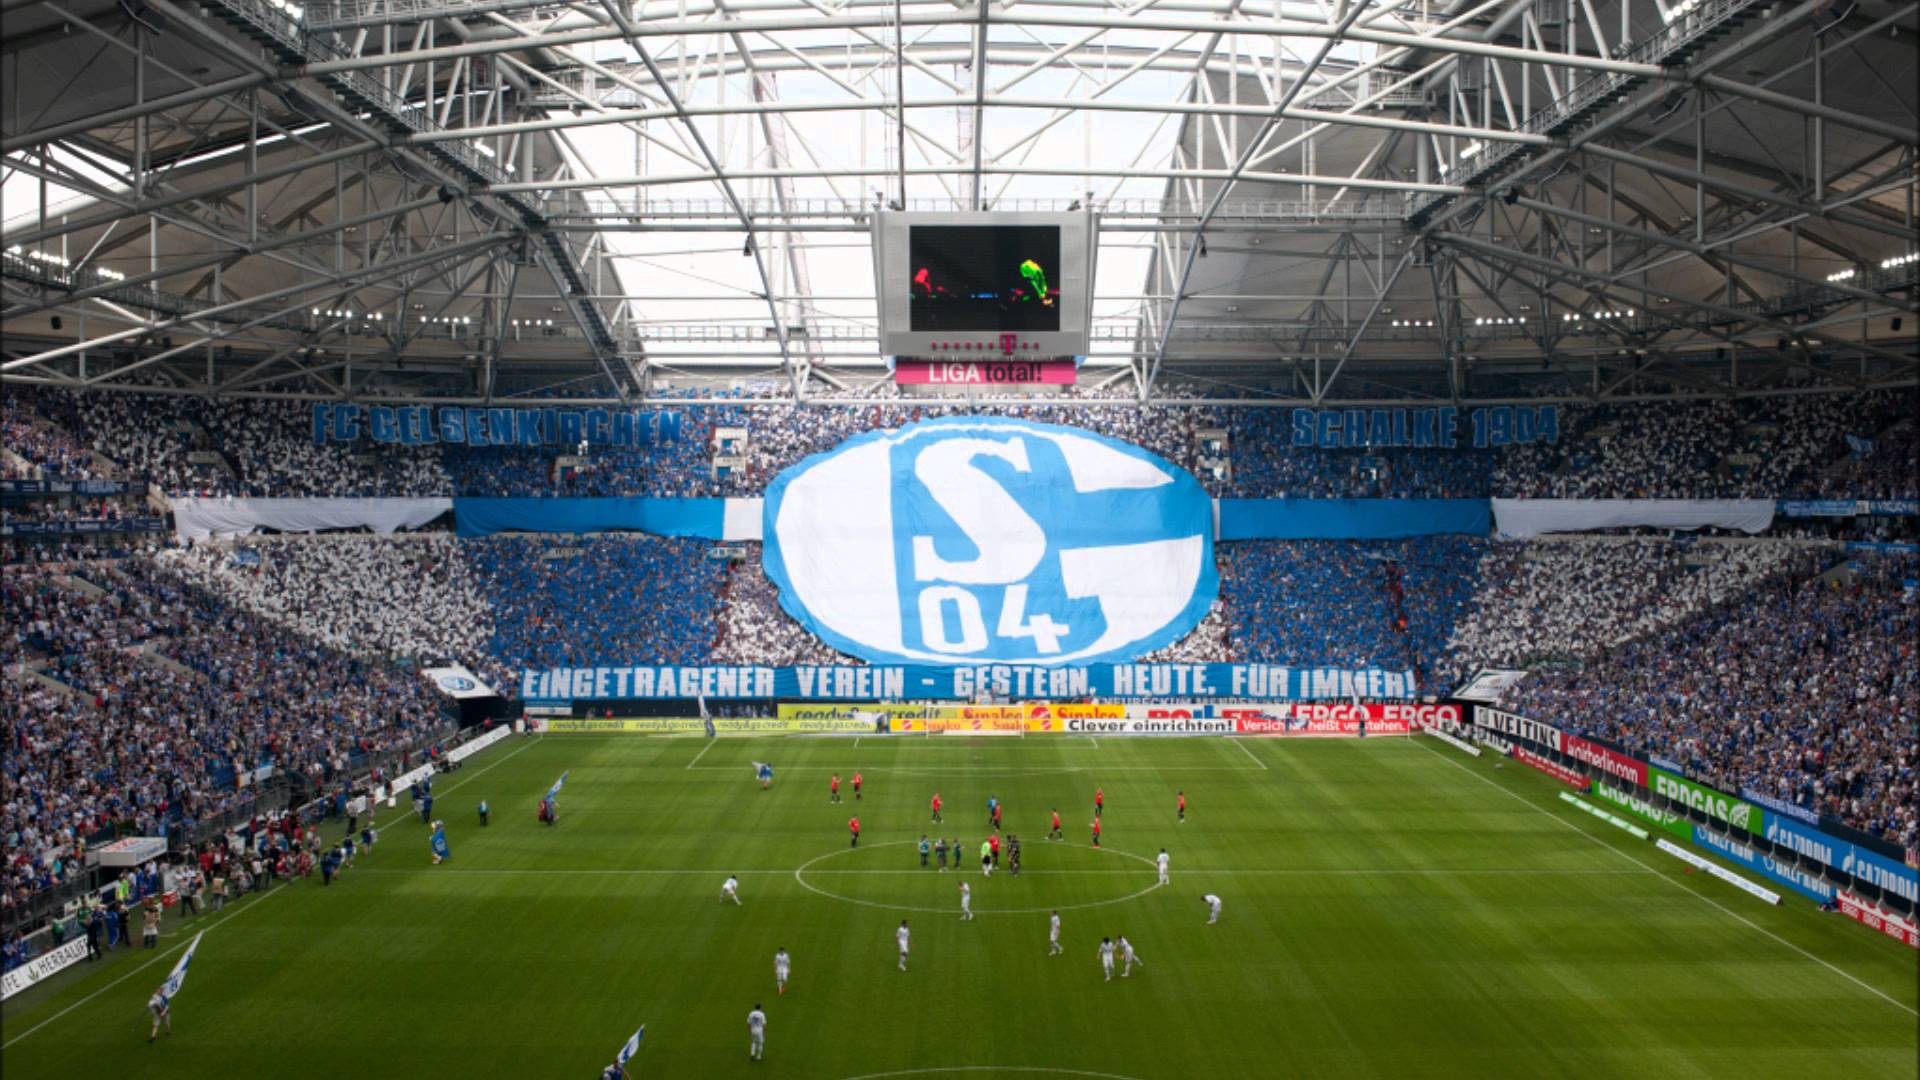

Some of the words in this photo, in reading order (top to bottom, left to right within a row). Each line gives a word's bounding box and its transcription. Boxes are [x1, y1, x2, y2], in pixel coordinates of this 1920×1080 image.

[928, 362, 980, 383] LIGA
[985, 362, 1042, 383] total!
[313, 403, 360, 445] FC
[369, 405, 683, 447] GELSENKIRCHEN
[1291, 407, 1457, 448] SCHALKE
[1472, 405, 1560, 446] 1904
[523, 667, 774, 698] EINGETRAGENER
[795, 666, 904, 697] VEREIN
[1232, 663, 1289, 697] FÜR
[1301, 668, 1415, 699] IMMER!
[1057, 705, 1118, 719] Sinalco
[1068, 719, 1125, 732] Clever
[1133, 718, 1232, 732] einrichten!
[1383, 704, 1458, 730] ERGO
[1656, 775, 1729, 821] ERDGAS
